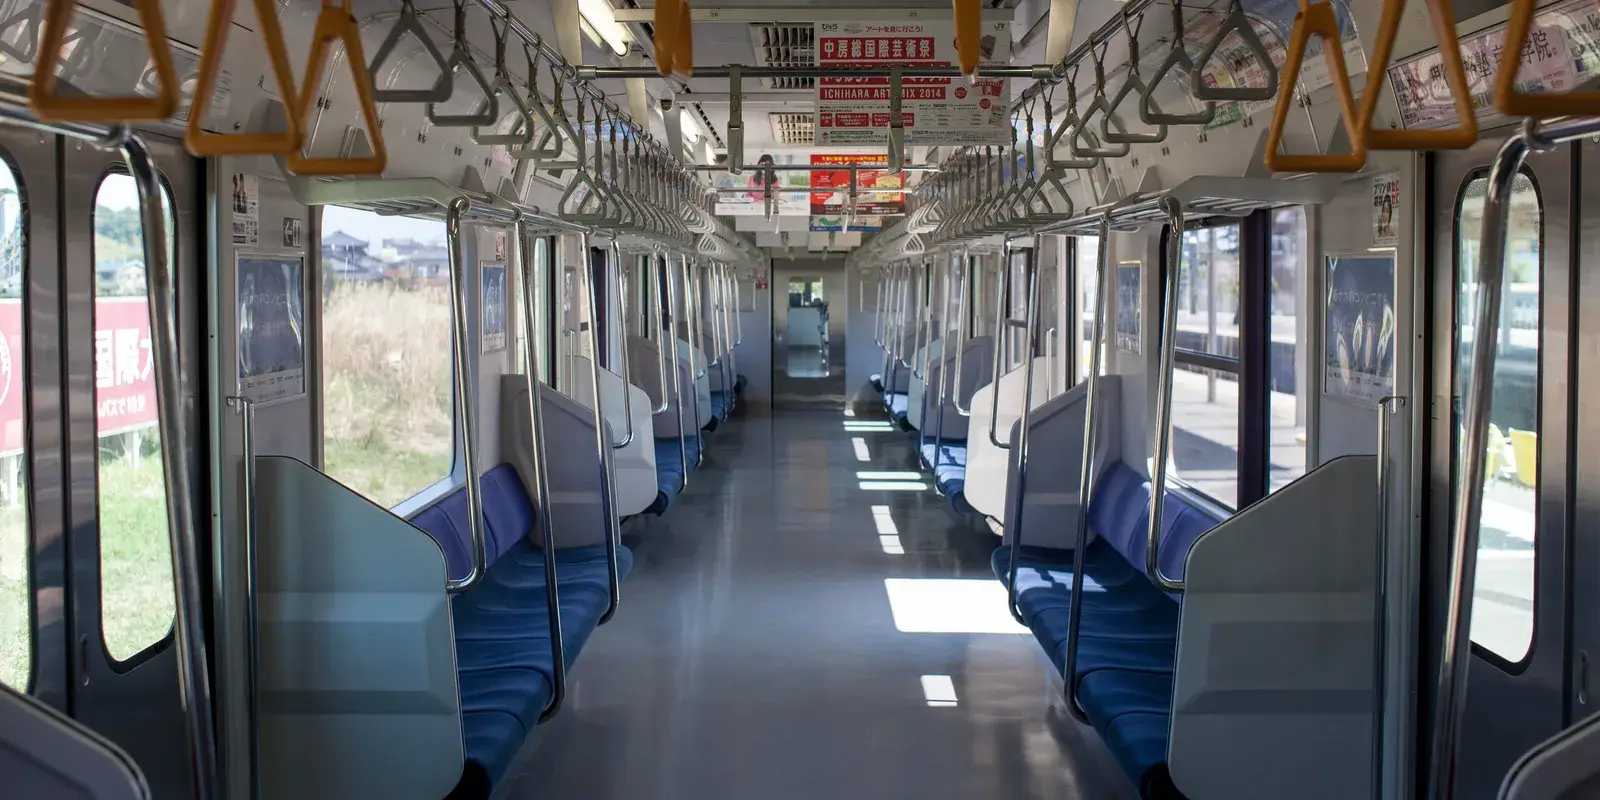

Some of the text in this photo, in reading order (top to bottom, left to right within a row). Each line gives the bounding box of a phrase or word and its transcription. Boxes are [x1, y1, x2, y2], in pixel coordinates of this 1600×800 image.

[824, 39, 930, 58] 中房総国際芸術祭
[825, 89, 870, 98] ICHIHARA
[920, 88, 941, 98] 2014
